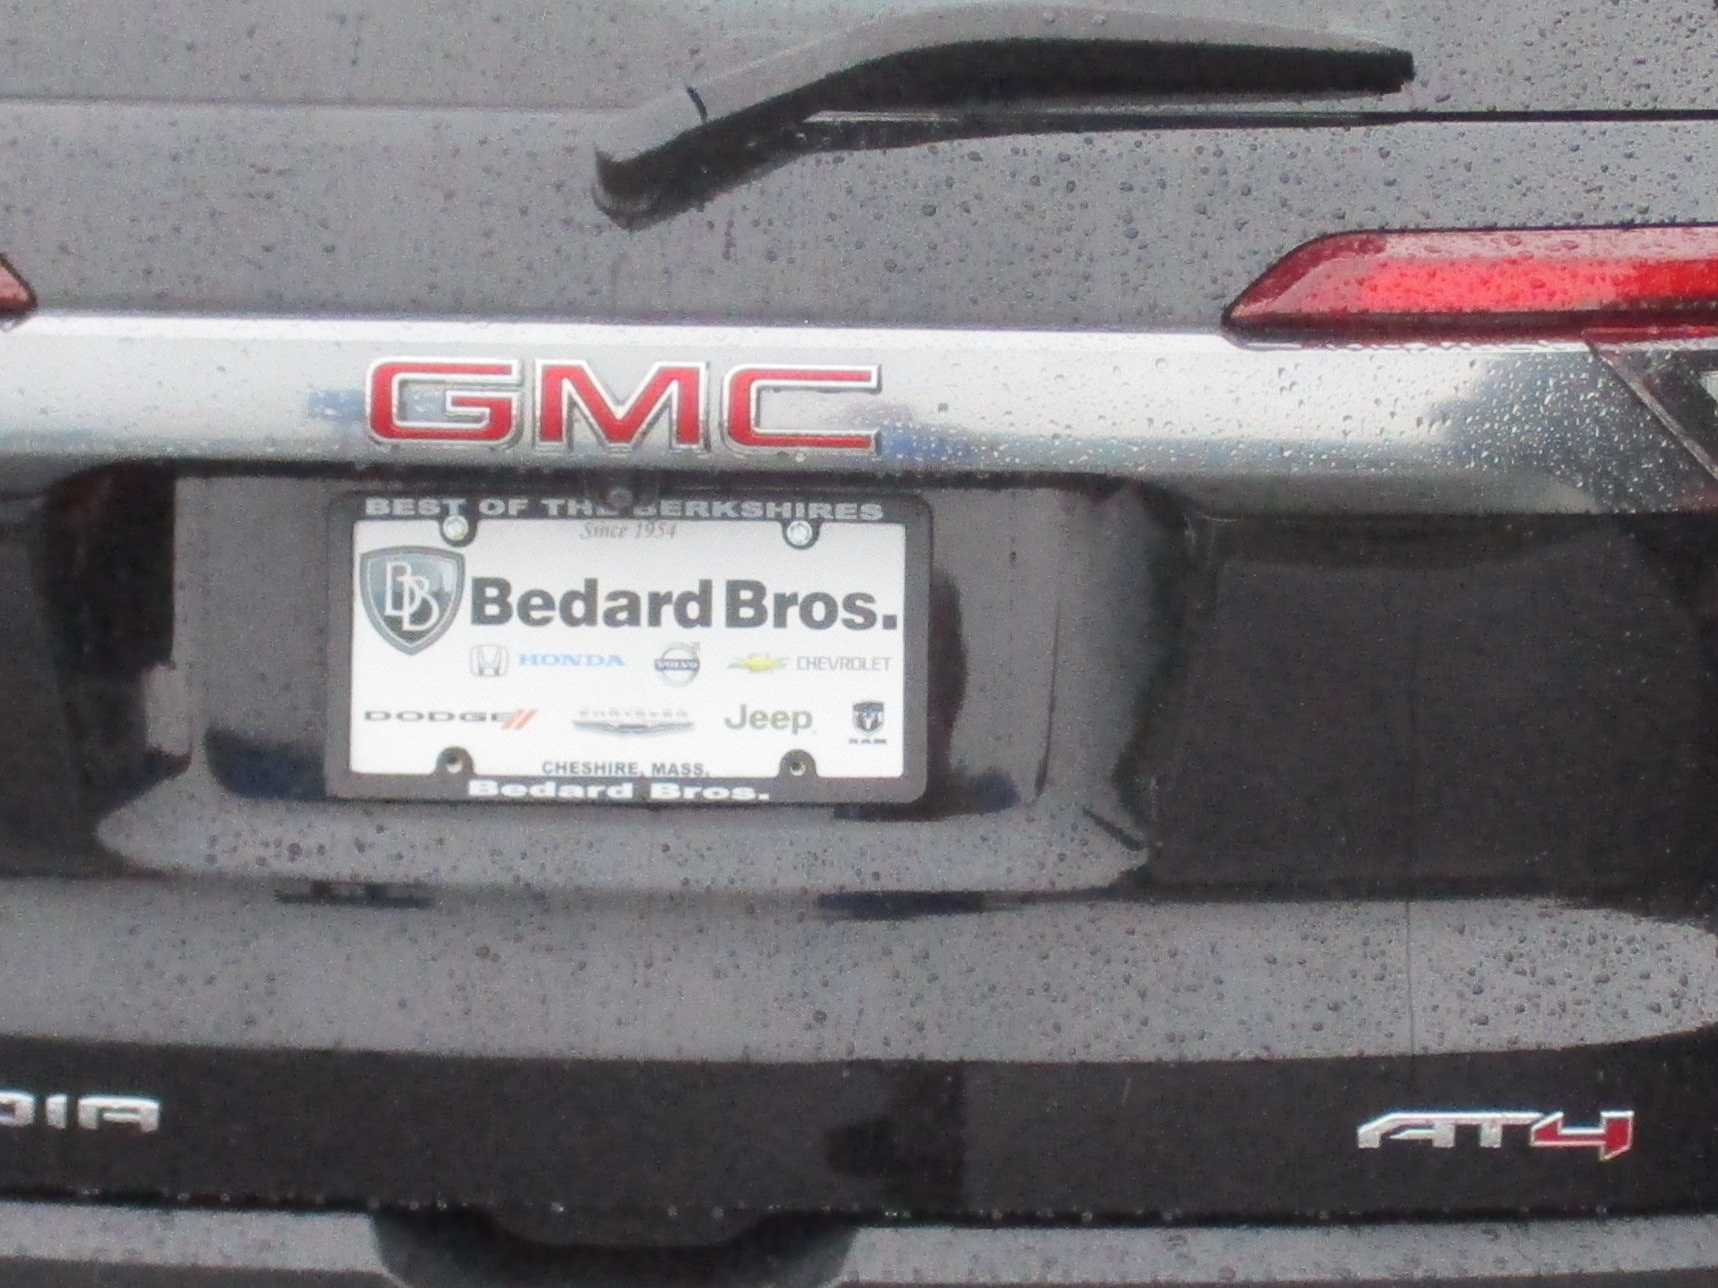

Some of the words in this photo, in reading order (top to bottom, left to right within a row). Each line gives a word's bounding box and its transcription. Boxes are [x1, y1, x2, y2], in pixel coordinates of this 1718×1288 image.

[366, 355, 883, 456] GMC
[365, 498, 467, 516] BEST
[478, 499, 529, 516] OF
[635, 520, 677, 539] 1954
[518, 653, 626, 667] HONDA
[796, 656, 891, 671] CHEVROLET
[723, 703, 813, 735] Jeep
[468, 779, 633, 799] Bedard
[650, 783, 769, 800] Bros.
[1357, 1111, 1634, 1161] AT4
